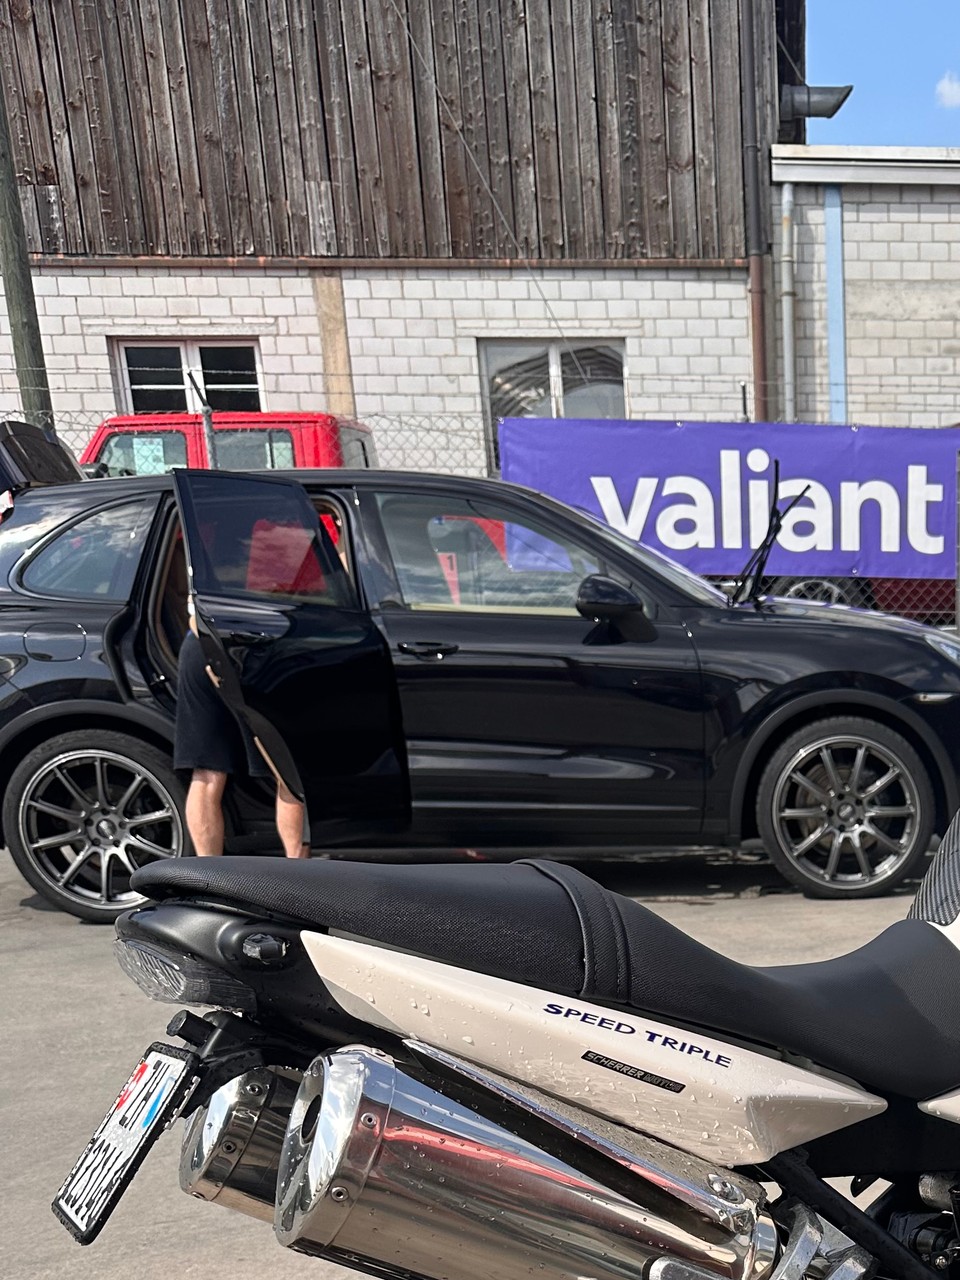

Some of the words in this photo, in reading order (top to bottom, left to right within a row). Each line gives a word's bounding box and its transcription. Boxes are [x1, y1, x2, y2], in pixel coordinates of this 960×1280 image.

[590, 449, 945, 554] valiant
[543, 1003, 636, 1035] SPEED
[645, 1030, 732, 1068] TRIPLE
[585, 1052, 644, 1079] SCHERRER
[118, 1060, 171, 1132] ZH
